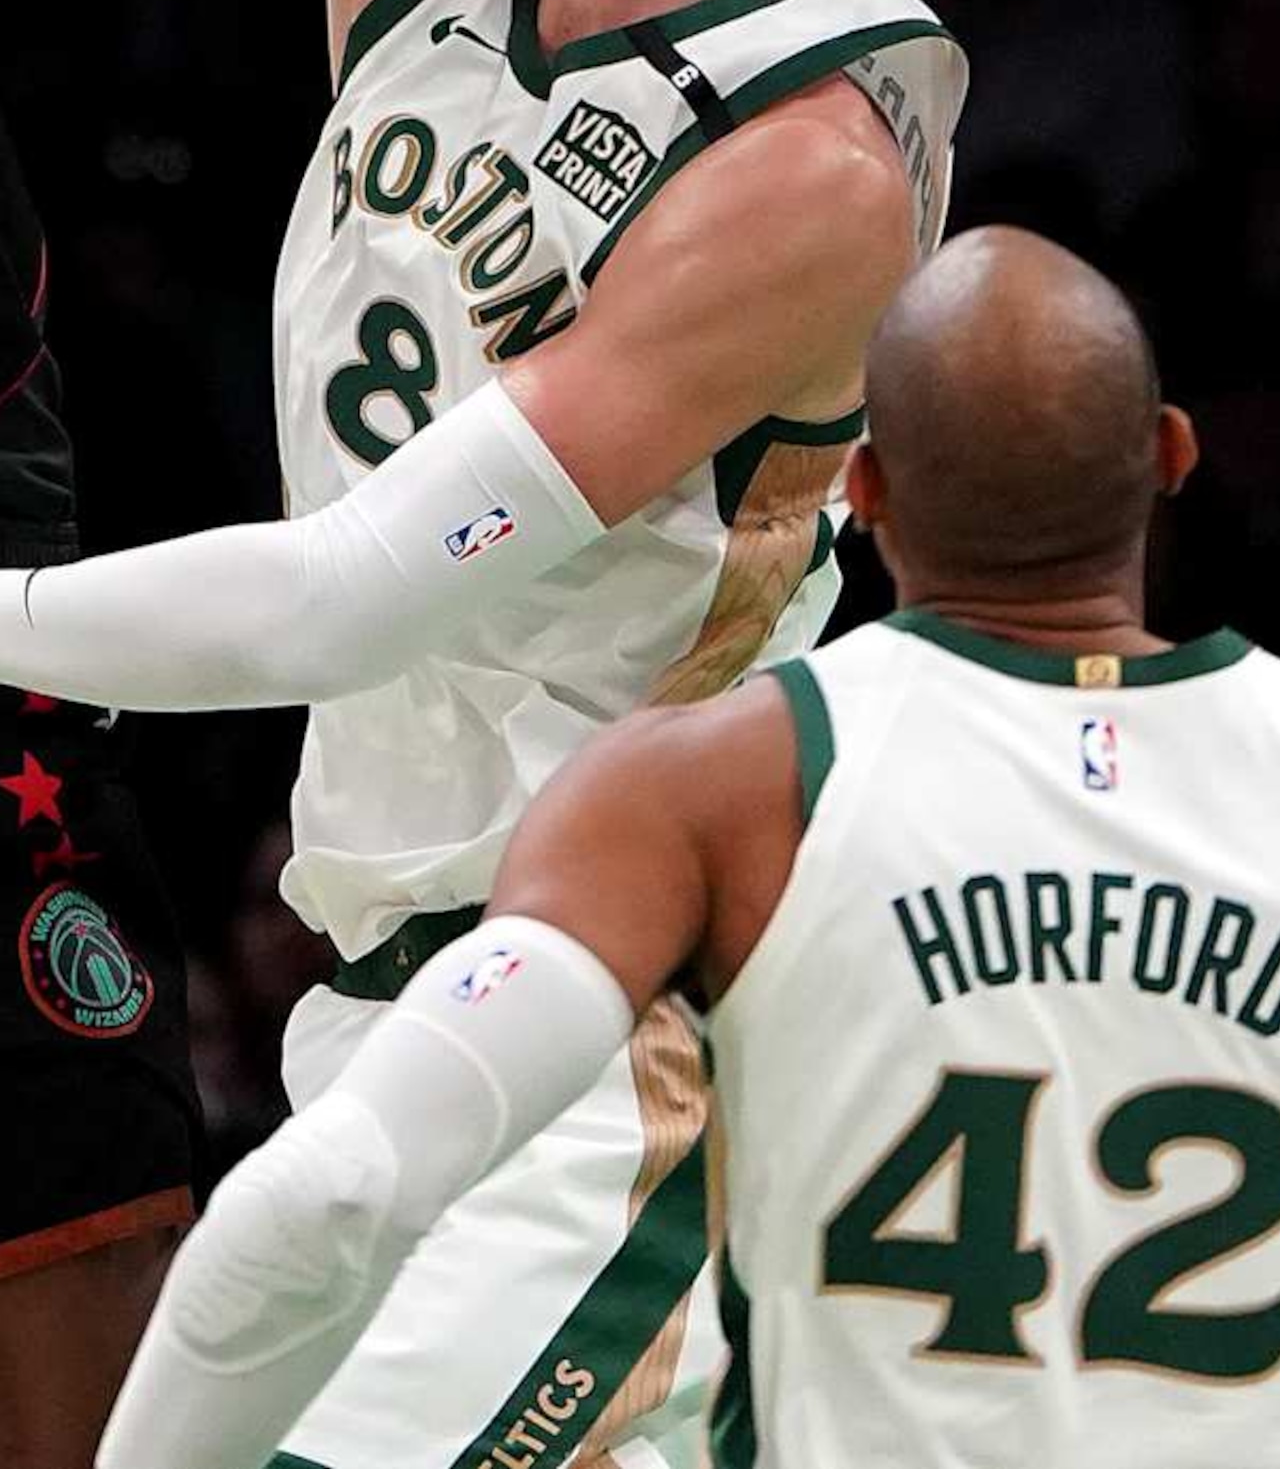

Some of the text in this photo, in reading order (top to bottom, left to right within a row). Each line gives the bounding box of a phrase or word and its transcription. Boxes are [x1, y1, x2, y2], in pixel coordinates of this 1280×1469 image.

[538, 139, 626, 215] PRINT
[564, 106, 648, 192] VISTA
[332, 115, 577, 363] BOSTON
[326, 295, 437, 467] 8
[75, 988, 144, 1028] WIZARDS
[477, 1359, 595, 1469] LTICS
